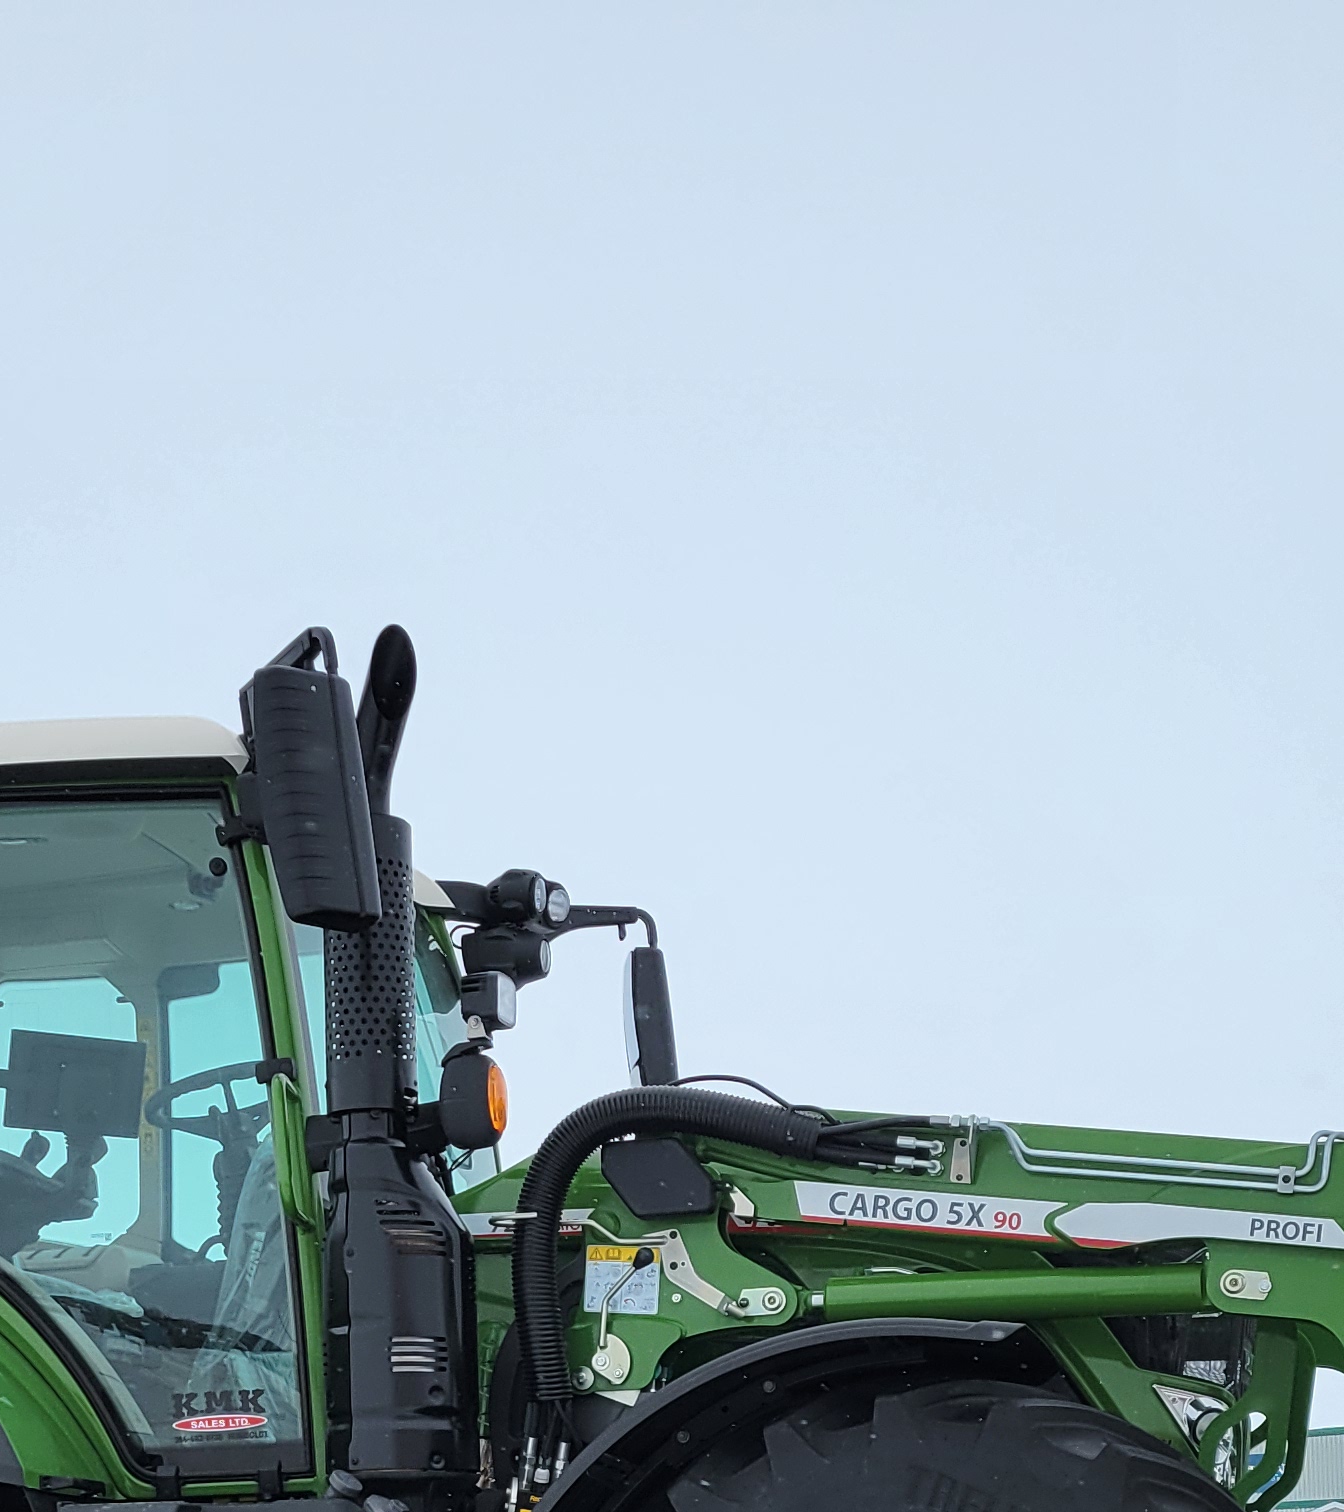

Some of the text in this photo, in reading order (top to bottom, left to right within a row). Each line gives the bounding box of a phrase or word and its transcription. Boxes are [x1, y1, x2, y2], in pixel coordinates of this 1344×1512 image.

[829, 1191, 1022, 1231] CARGO 5X 90
[1249, 1217, 1324, 1243] PROFI
[191, 1419, 226, 1429] SALES
